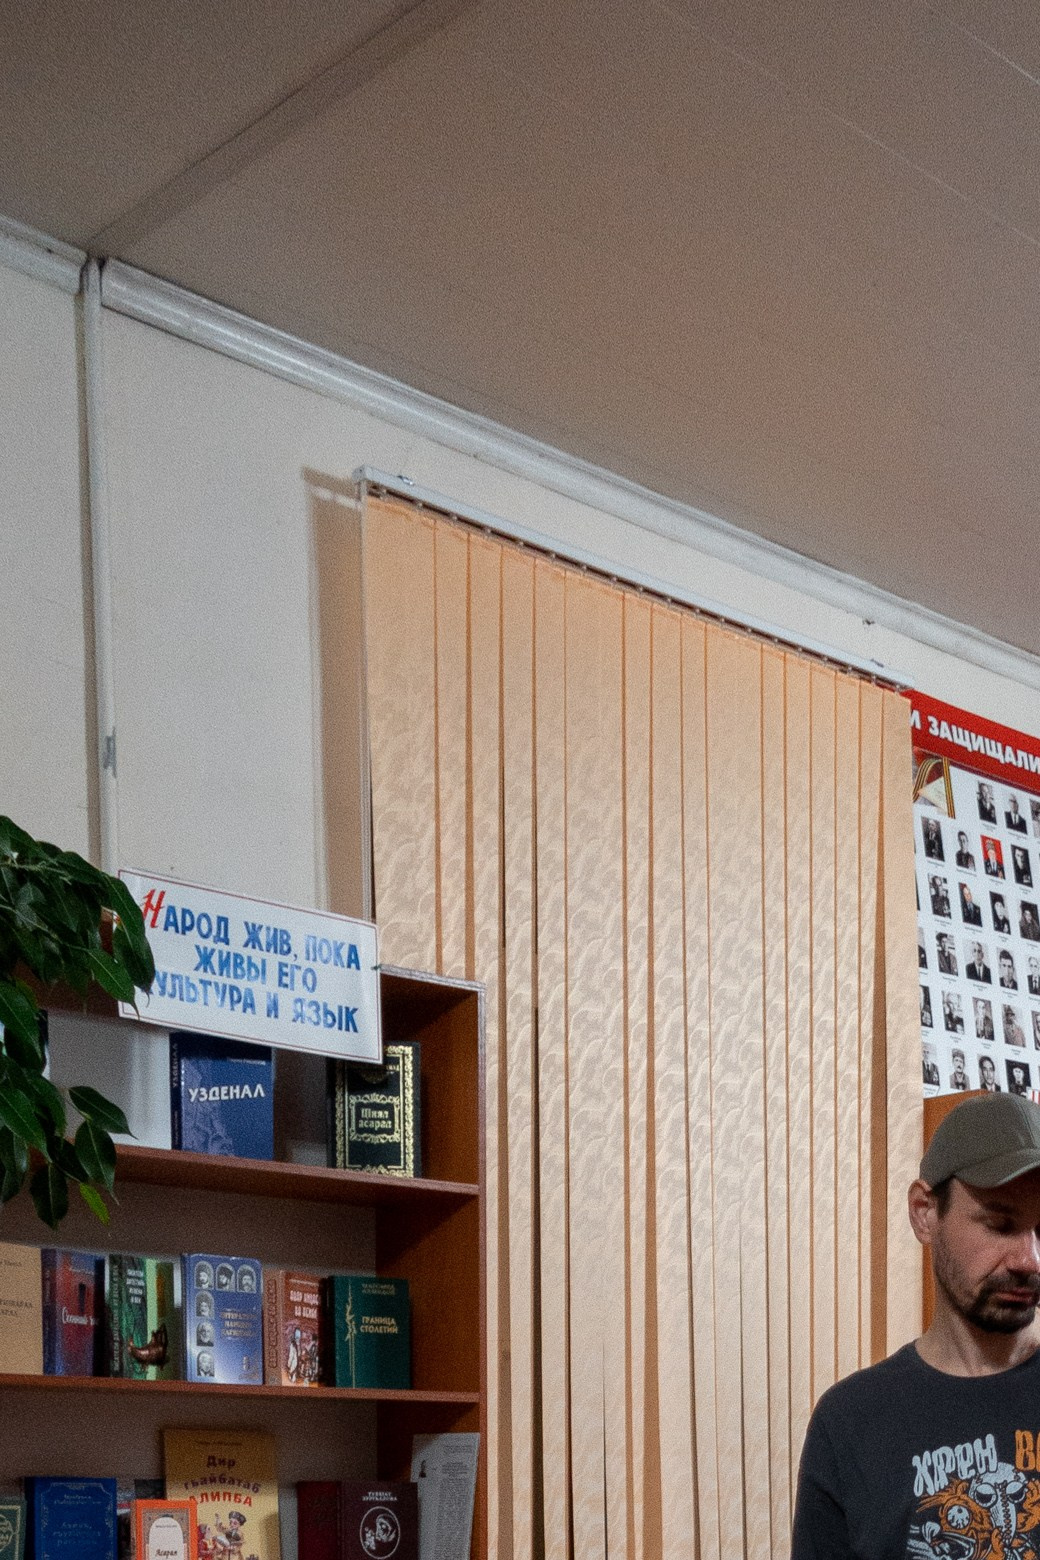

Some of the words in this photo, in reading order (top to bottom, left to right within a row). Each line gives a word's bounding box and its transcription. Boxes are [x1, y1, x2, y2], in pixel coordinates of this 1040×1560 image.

[141, 888, 230, 946] НАРОД
[242, 920, 298, 960] ЖИВ,
[304, 934, 361, 971] ПОКА
[193, 943, 267, 985] ЖИВЫ
[277, 961, 318, 994] ЕГО
[266, 991, 279, 1019] И
[292, 996, 360, 1034] ЯЗЫК
[188, 1083, 266, 1103] УЗДЕНАЛ
[361, 1316, 397, 1326] ГРАНИЦА
[206, 1455, 237, 1470] Дир
